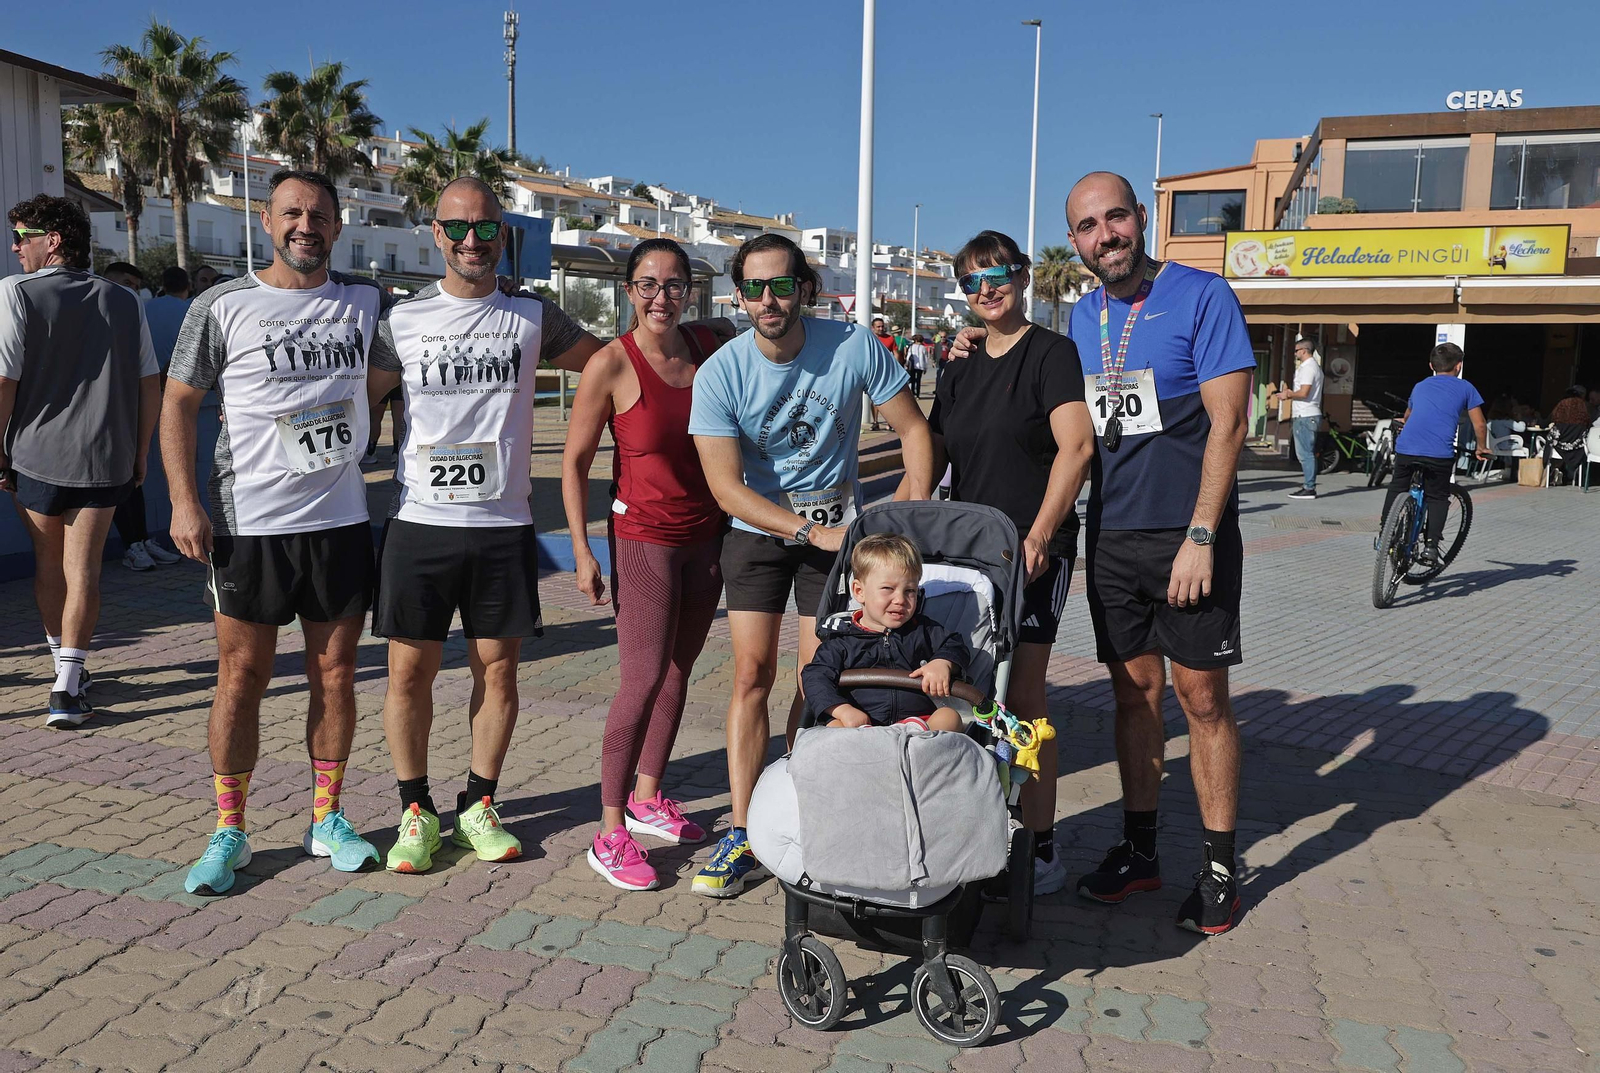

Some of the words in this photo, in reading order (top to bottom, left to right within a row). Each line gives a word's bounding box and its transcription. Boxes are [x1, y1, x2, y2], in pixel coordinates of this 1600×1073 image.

[1446, 89, 1523, 110] CEPAS
[1301, 246, 1393, 266] Heladería
[1511, 244, 1551, 257] Lechera
[259, 319, 287, 328] Corre,
[289, 317, 312, 325] corre
[314, 317, 331, 326] que
[332, 316, 341, 324] te
[343, 315, 358, 326] pillo
[421, 334, 447, 343] Corre,
[449, 332, 471, 341] corre
[474, 332, 490, 340] que
[265, 376, 292, 384] Amigos
[307, 374, 328, 382] llegan
[459, 388, 478, 396] llegan
[766, 391, 794, 422] URBANA
[797, 389, 828, 406] CIUDAD
[826, 403, 838, 416] DE
[298, 422, 352, 454] 176
[430, 463, 486, 486] 220
